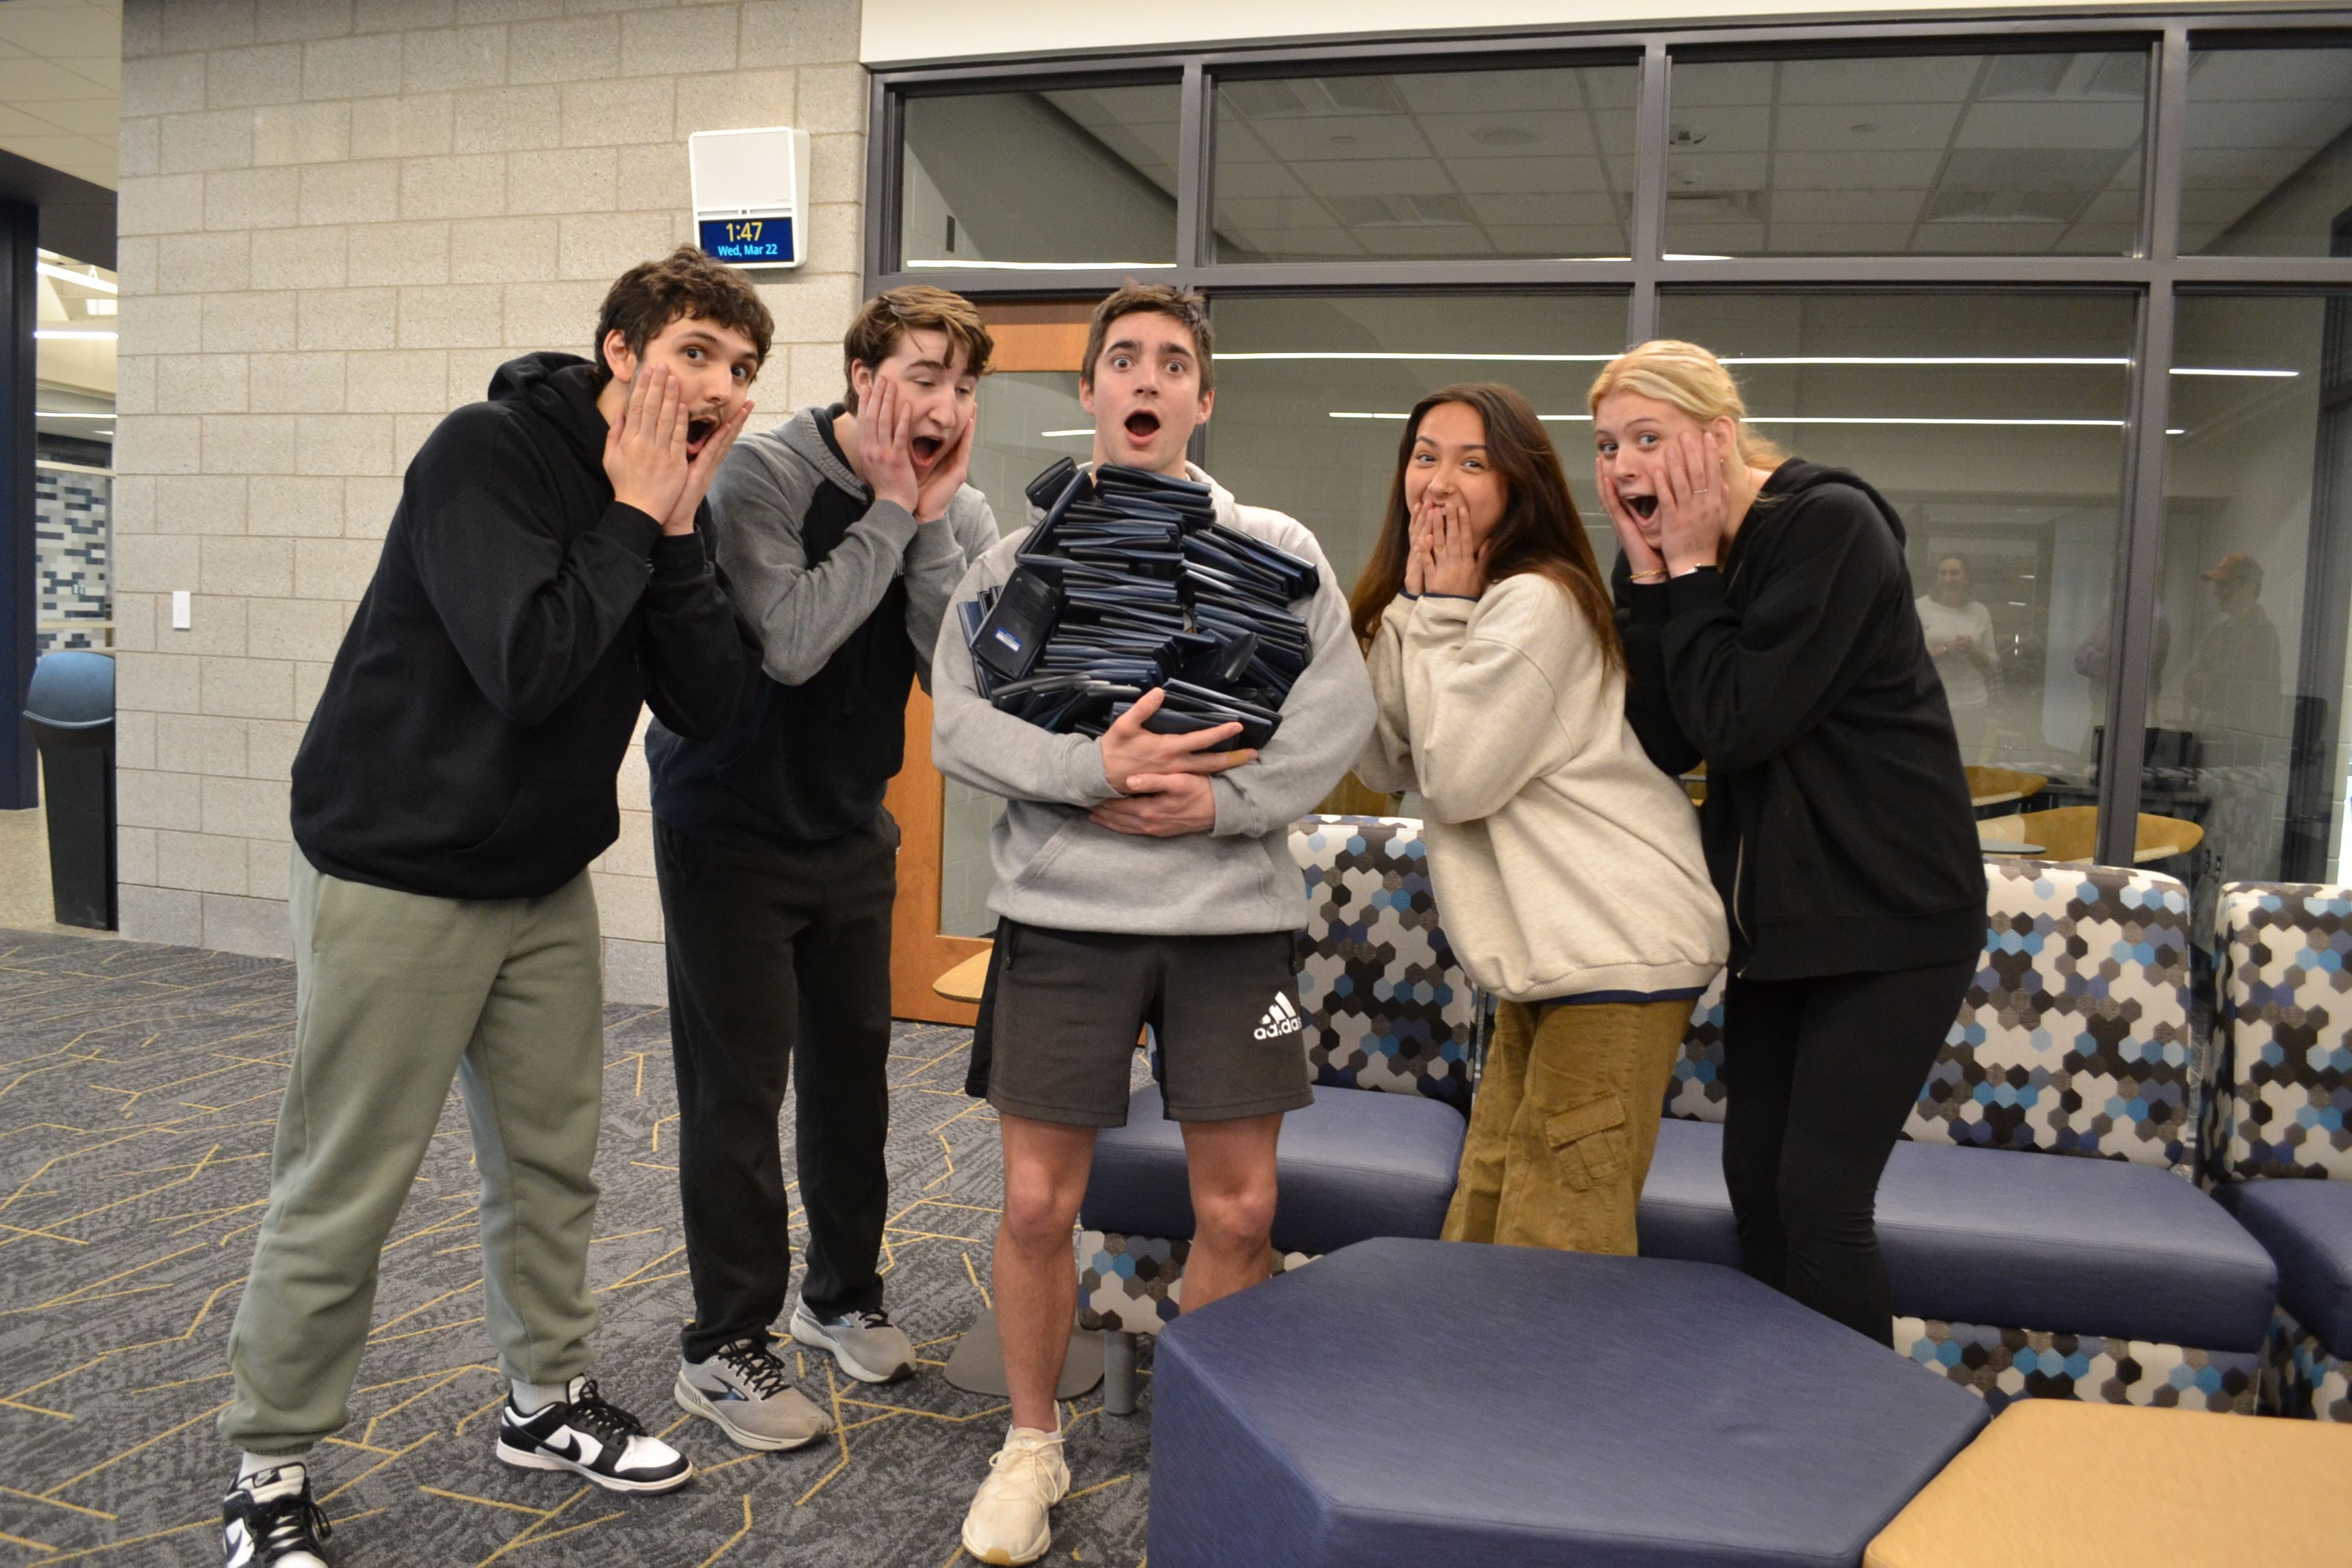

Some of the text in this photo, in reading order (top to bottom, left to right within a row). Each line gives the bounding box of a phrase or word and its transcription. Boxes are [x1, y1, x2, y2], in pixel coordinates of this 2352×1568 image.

[726, 222, 762, 242] 1:47
[717, 243, 778, 257] Wed, Mar 22
